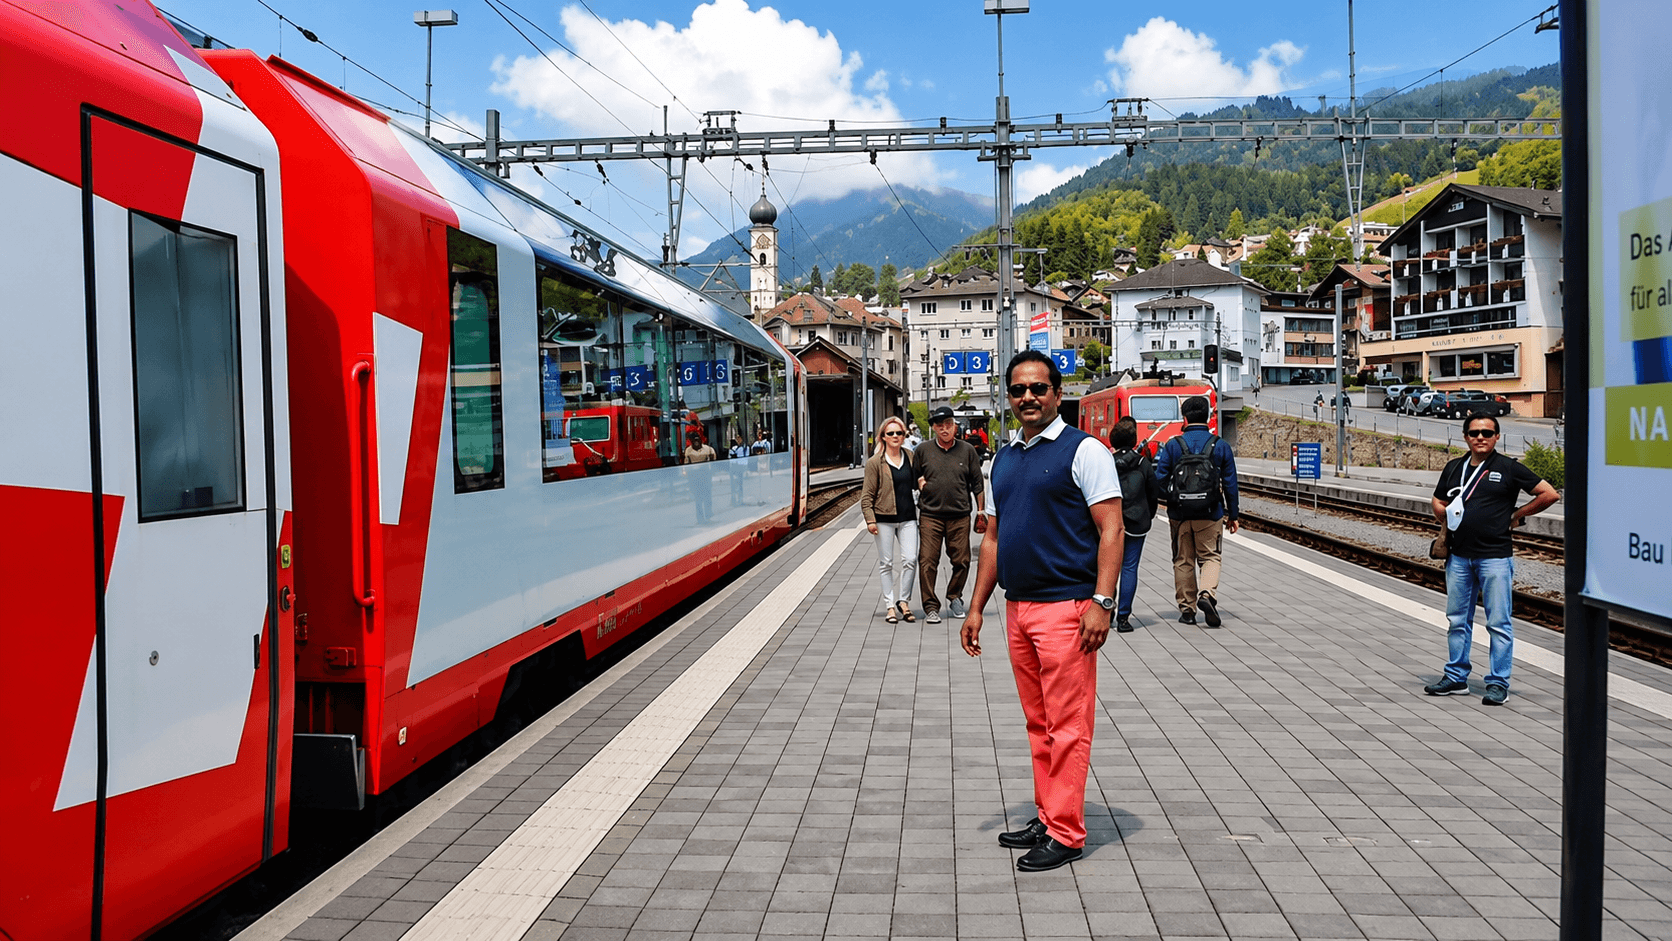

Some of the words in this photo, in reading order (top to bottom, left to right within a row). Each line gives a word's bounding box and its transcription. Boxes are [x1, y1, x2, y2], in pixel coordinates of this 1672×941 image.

[1630, 233, 1662, 260] Das
[1630, 285, 1653, 311] für
[972, 356, 982, 369] 3
[1059, 355, 1069, 369] 3
[1629, 406, 1669, 441] NA
[1629, 532, 1664, 564] Bau
